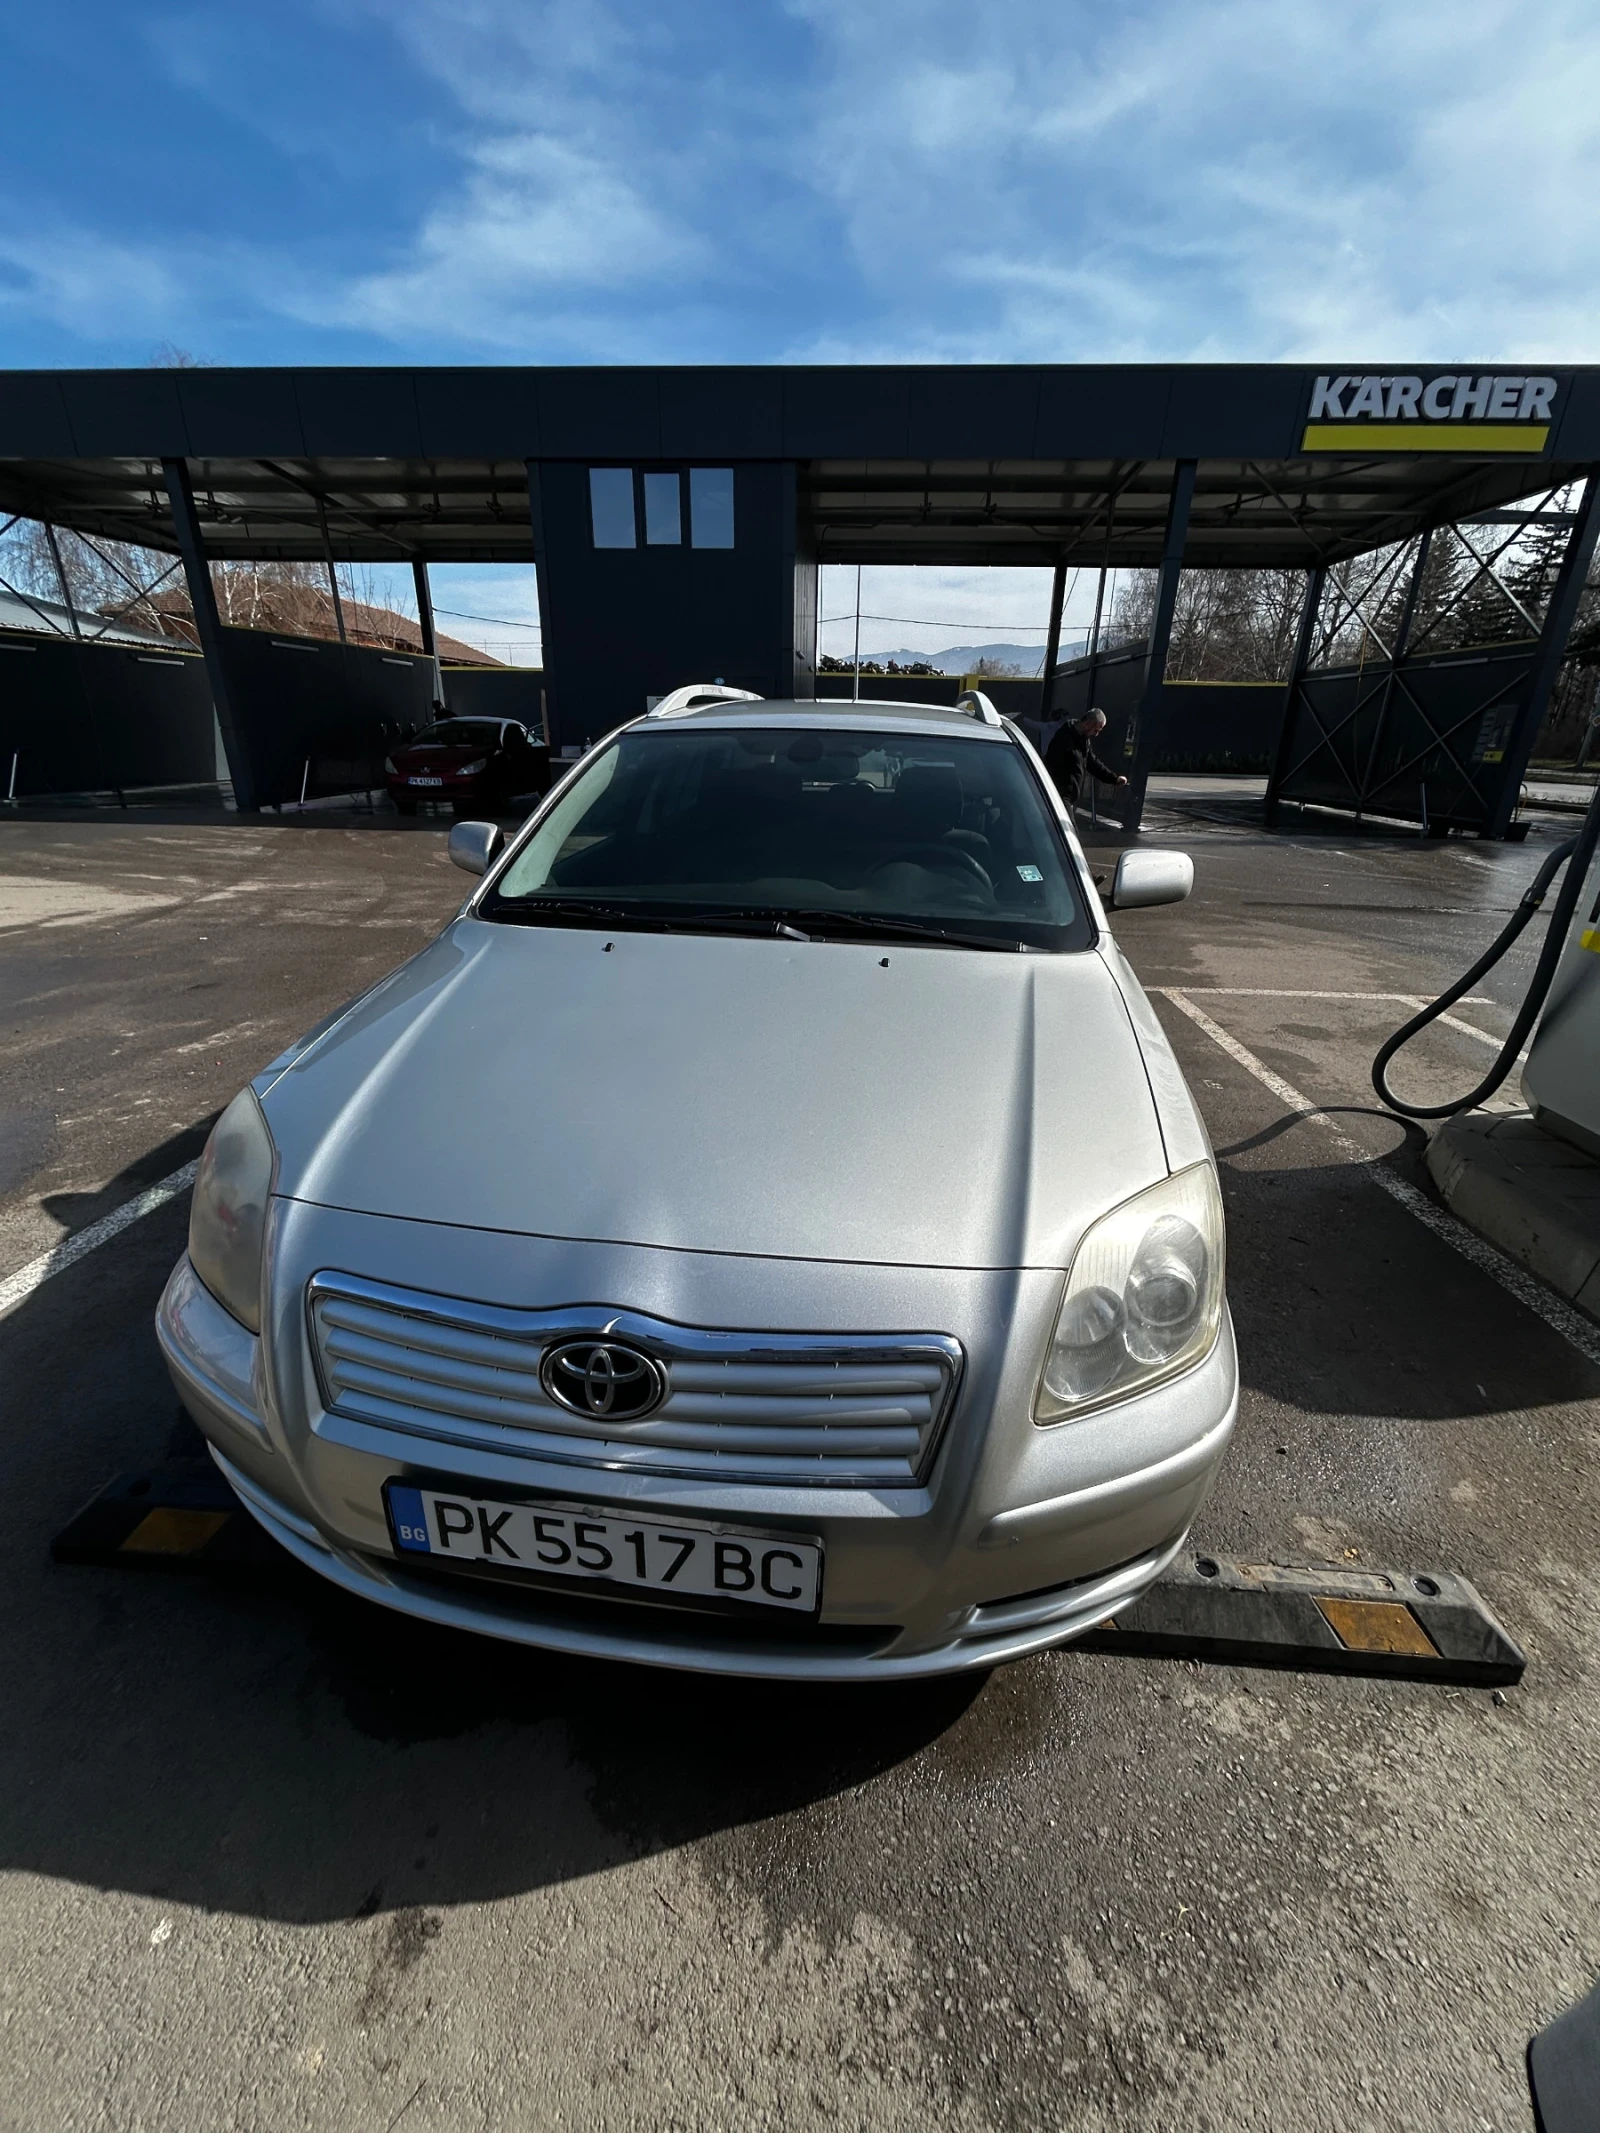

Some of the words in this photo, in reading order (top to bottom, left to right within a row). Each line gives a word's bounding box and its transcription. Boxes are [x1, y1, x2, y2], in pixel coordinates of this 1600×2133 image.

[1308, 376, 1557, 420] KÄRCHER
[400, 1525, 425, 1542] BG
[433, 1500, 521, 1559] PK
[533, 1518, 696, 1582] 5517
[714, 1542, 803, 1599] BC
